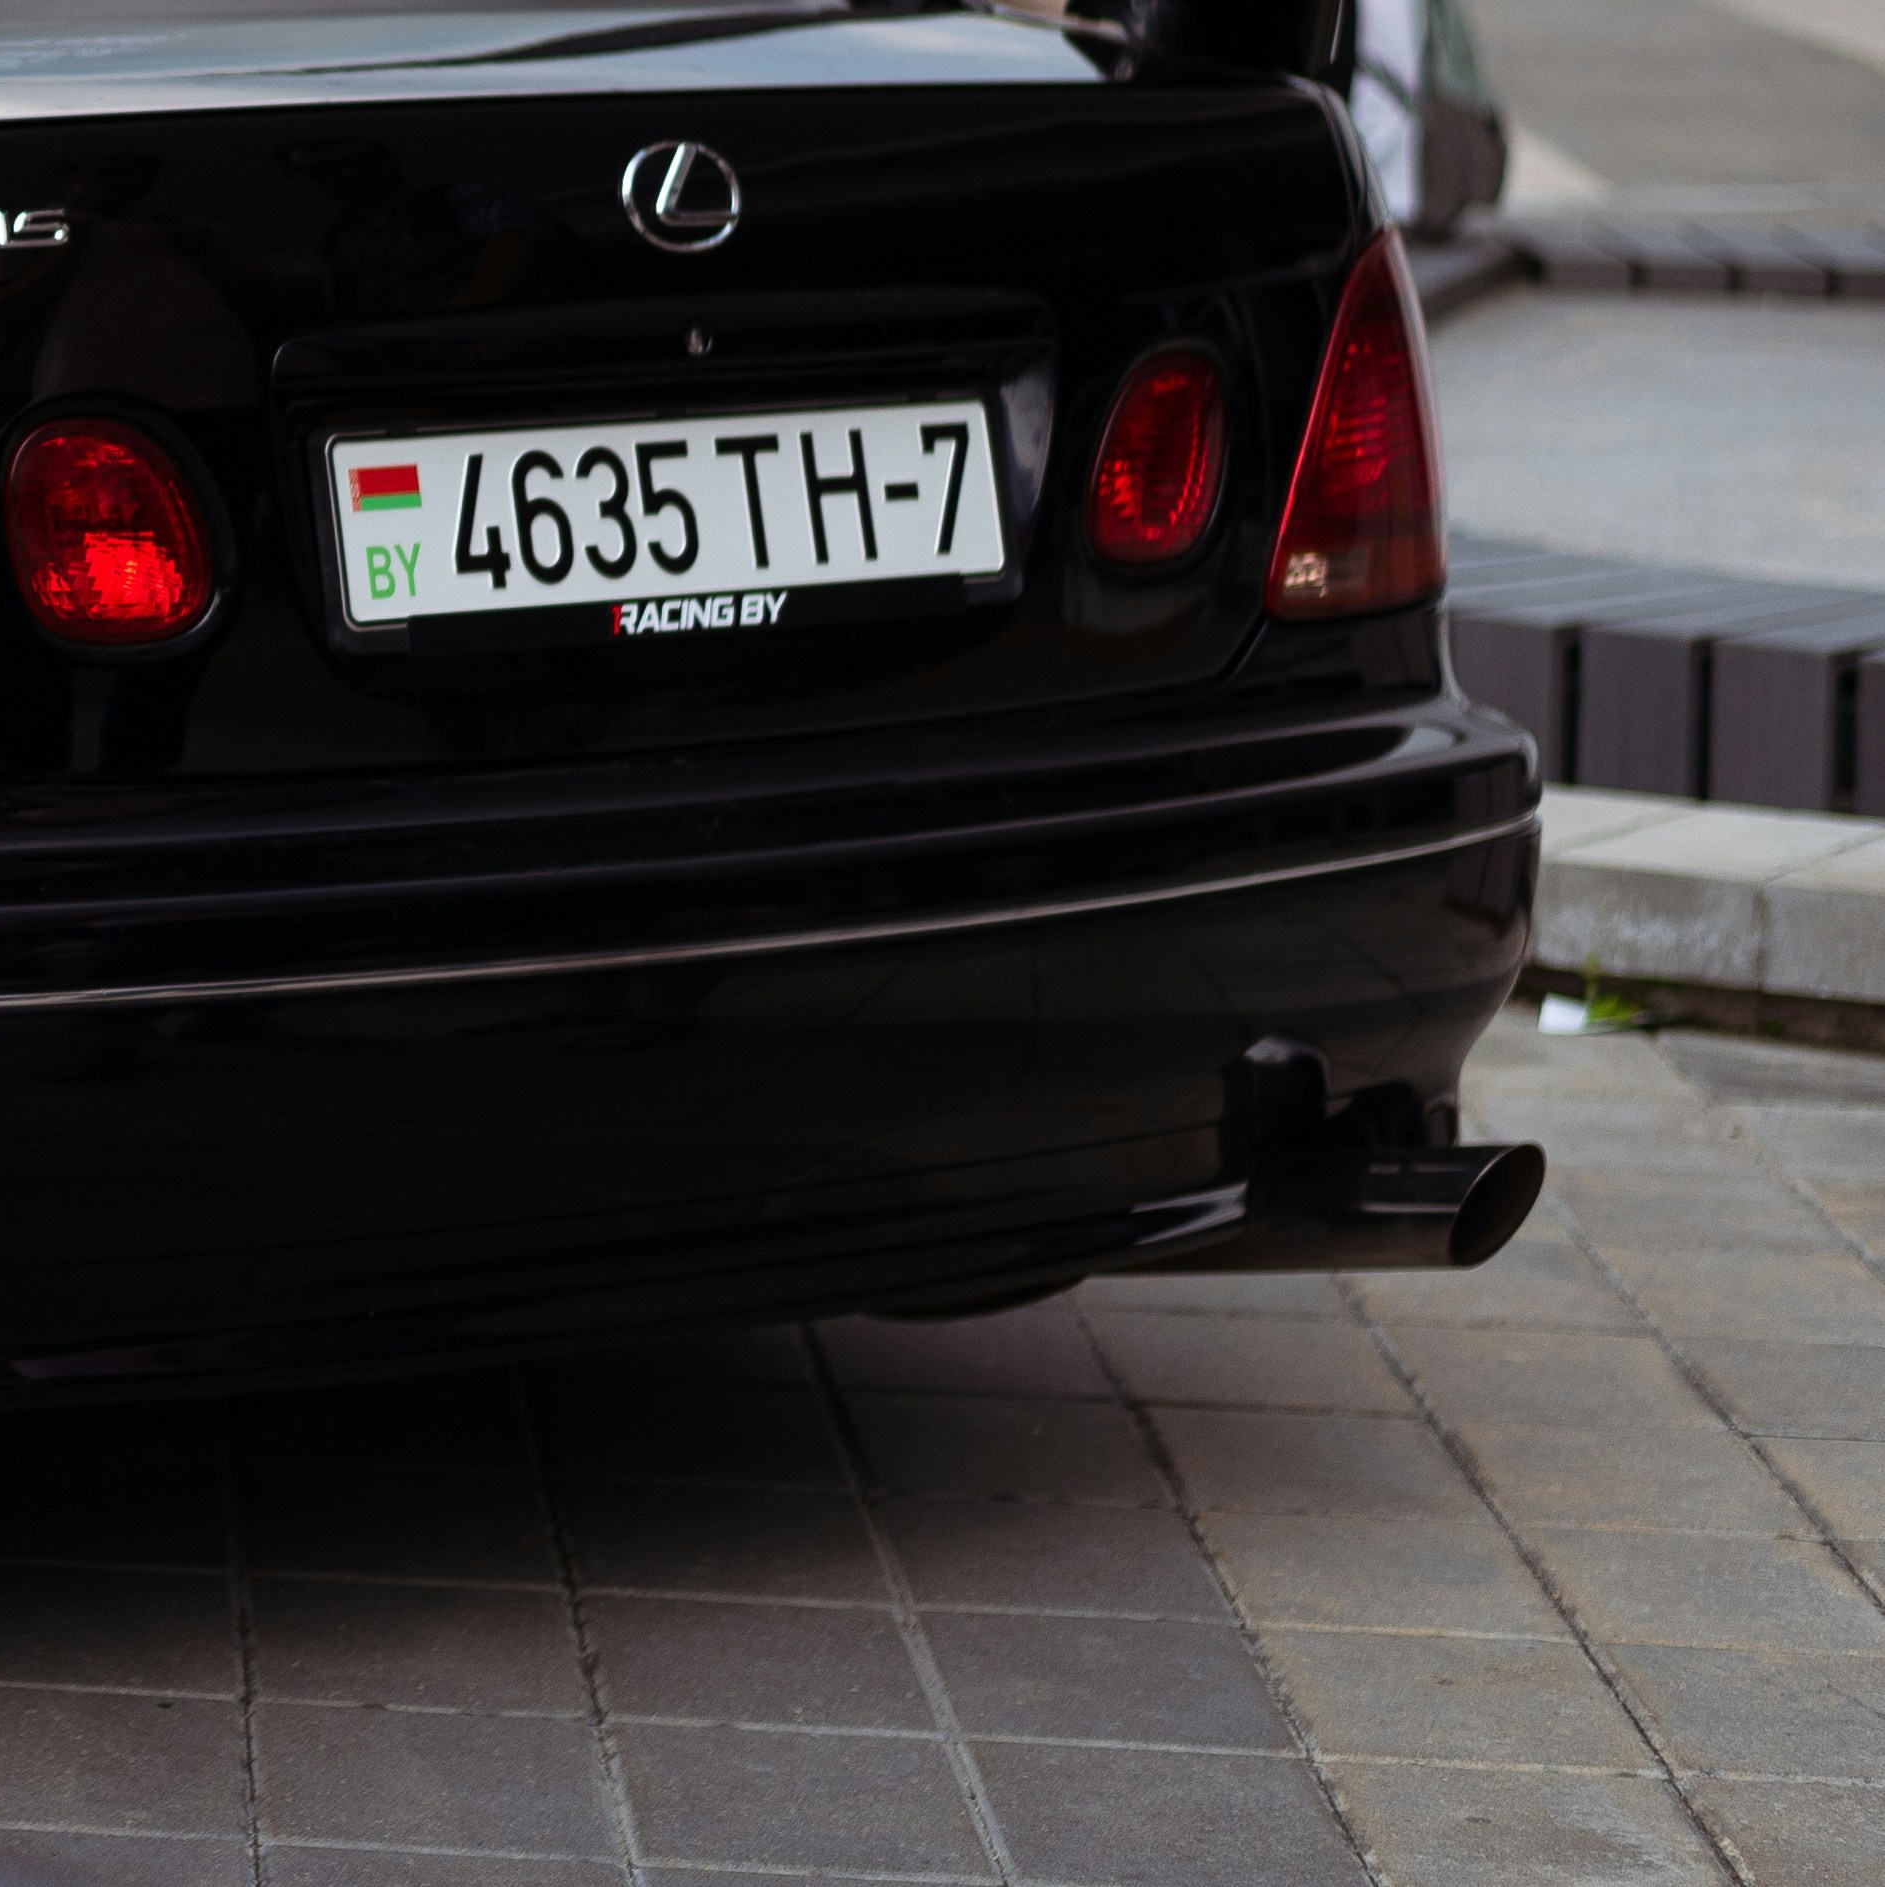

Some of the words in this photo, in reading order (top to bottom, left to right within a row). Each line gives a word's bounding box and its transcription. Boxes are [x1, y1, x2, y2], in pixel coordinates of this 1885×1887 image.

[453, 440, 700, 589] 4635
[714, 422, 970, 569] TH-7
[366, 542, 421, 600] BY
[739, 590, 788, 626] BY
